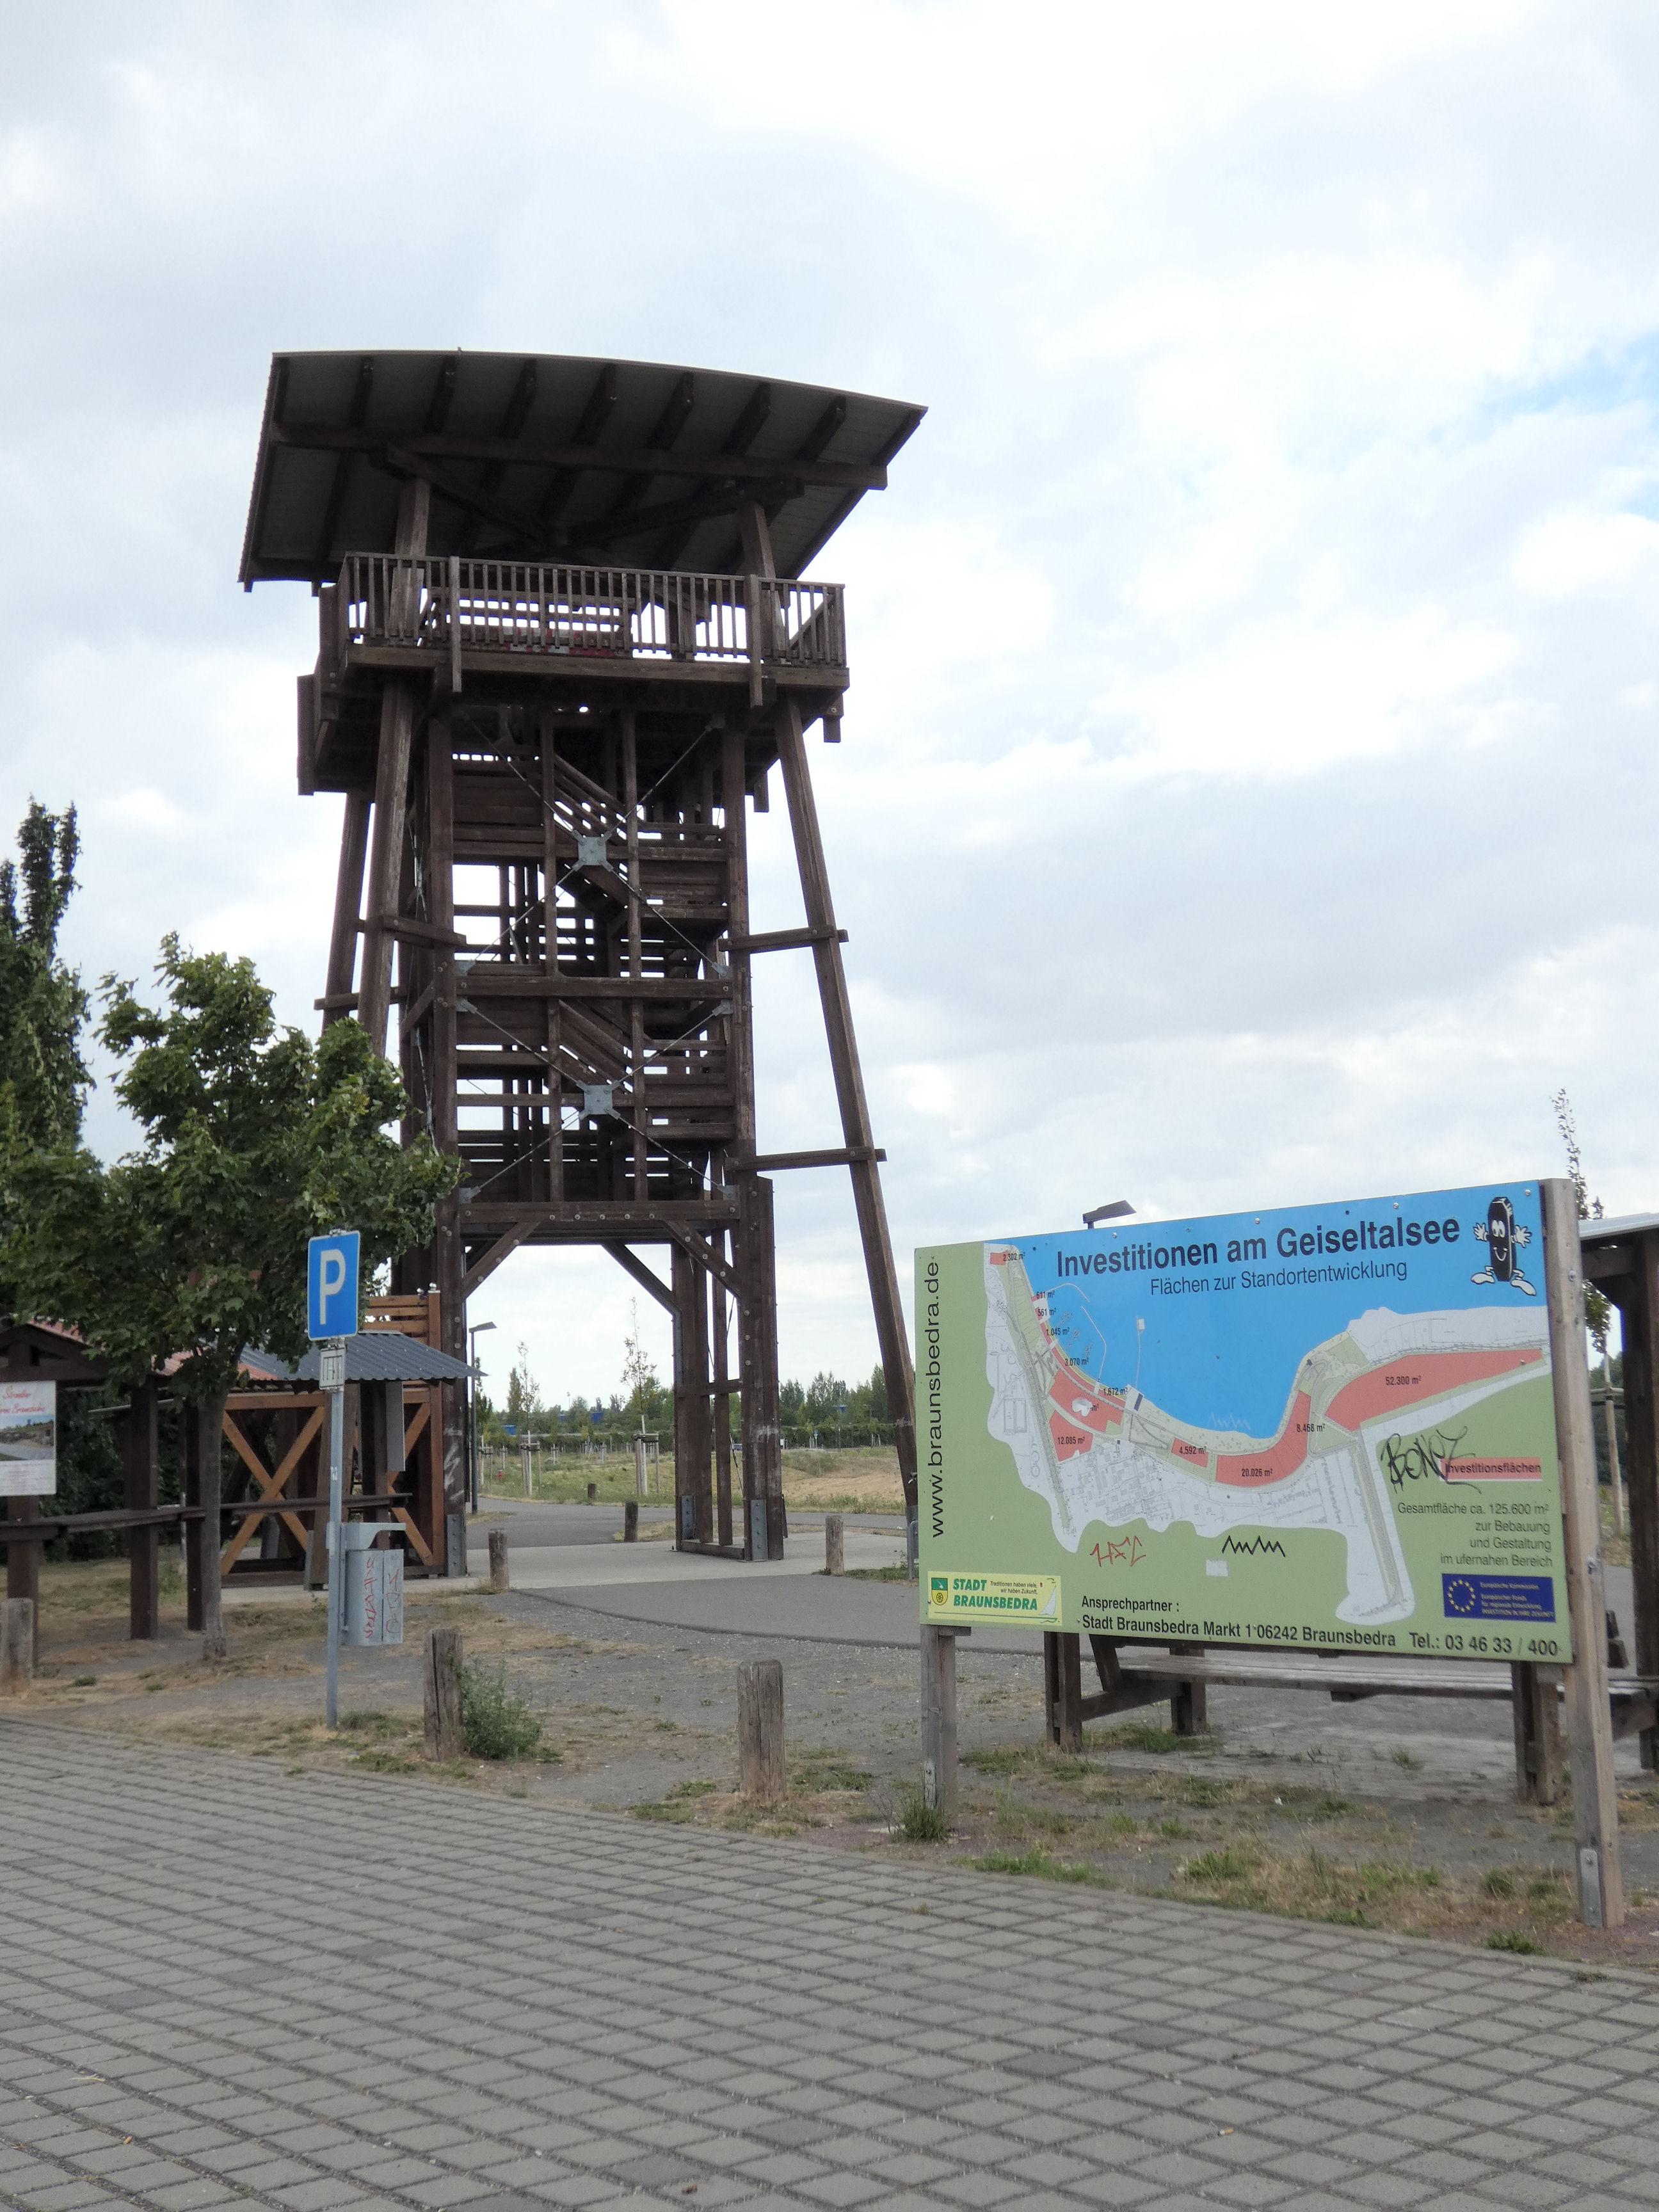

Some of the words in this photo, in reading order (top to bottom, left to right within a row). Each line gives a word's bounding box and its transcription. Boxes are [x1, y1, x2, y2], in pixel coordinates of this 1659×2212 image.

[1057, 1242, 1217, 1278] Investitionen
[1227, 1237, 1267, 1263] am
[1277, 1217, 1460, 1258] Geiseltalsee
[1003, 1253, 1017, 1261] 2.302
[1151, 1278, 1209, 1295] Flächen
[1214, 1276, 1236, 1291] zur
[1242, 1260, 1407, 1288] Standortentwicklung
[320, 1249, 346, 1325] P
[1064, 1358, 1080, 1366] 3.070
[1386, 1375, 1409, 1385] 52.300
[1103, 1388, 1118, 1396] 1.672
[924, 1262, 943, 1538] www.braunsbedra.de
[1057, 1436, 1076, 1445] 12.085
[1179, 1446, 1196, 1455] 4.592
[1445, 1463, 1541, 1474] Investitionsflächen
[1397, 1502, 1467, 1514] Gesamtfläche
[1470, 1505, 1485, 1514] ca.
[1489, 1503, 1532, 1515] 125.600
[1475, 1523, 1491, 1531] zur
[1495, 1520, 1550, 1535] Bebauung
[1470, 1537, 1490, 1548] und
[1493, 1537, 1551, 1552] Gestaltung
[1440, 1553, 1452, 1564] im
[1456, 1553, 1508, 1566] ufernahen
[1511, 1555, 1553, 1567] Bereich
[952, 1578, 987, 1591] STADT
[953, 1595, 1038, 1610] BRAUNSBEDRA
[1082, 1595, 1173, 1613] Ansprechpartner
[1082, 1614, 1113, 1630] Stadt
[1117, 1617, 1199, 1635] Braunsbedra
[1204, 1621, 1240, 1638] Markt
[1246, 1624, 1251, 1639] 1
[1256, 1624, 1298, 1641] 06242
[1302, 1626, 1396, 1647] Braunsbedra
[1409, 1631, 1439, 1649] Tel.:
[1445, 1634, 1463, 1651] 03
[1469, 1636, 1487, 1652] 46
[1493, 1637, 1512, 1653] 33
[1528, 1639, 1559, 1656] 400
